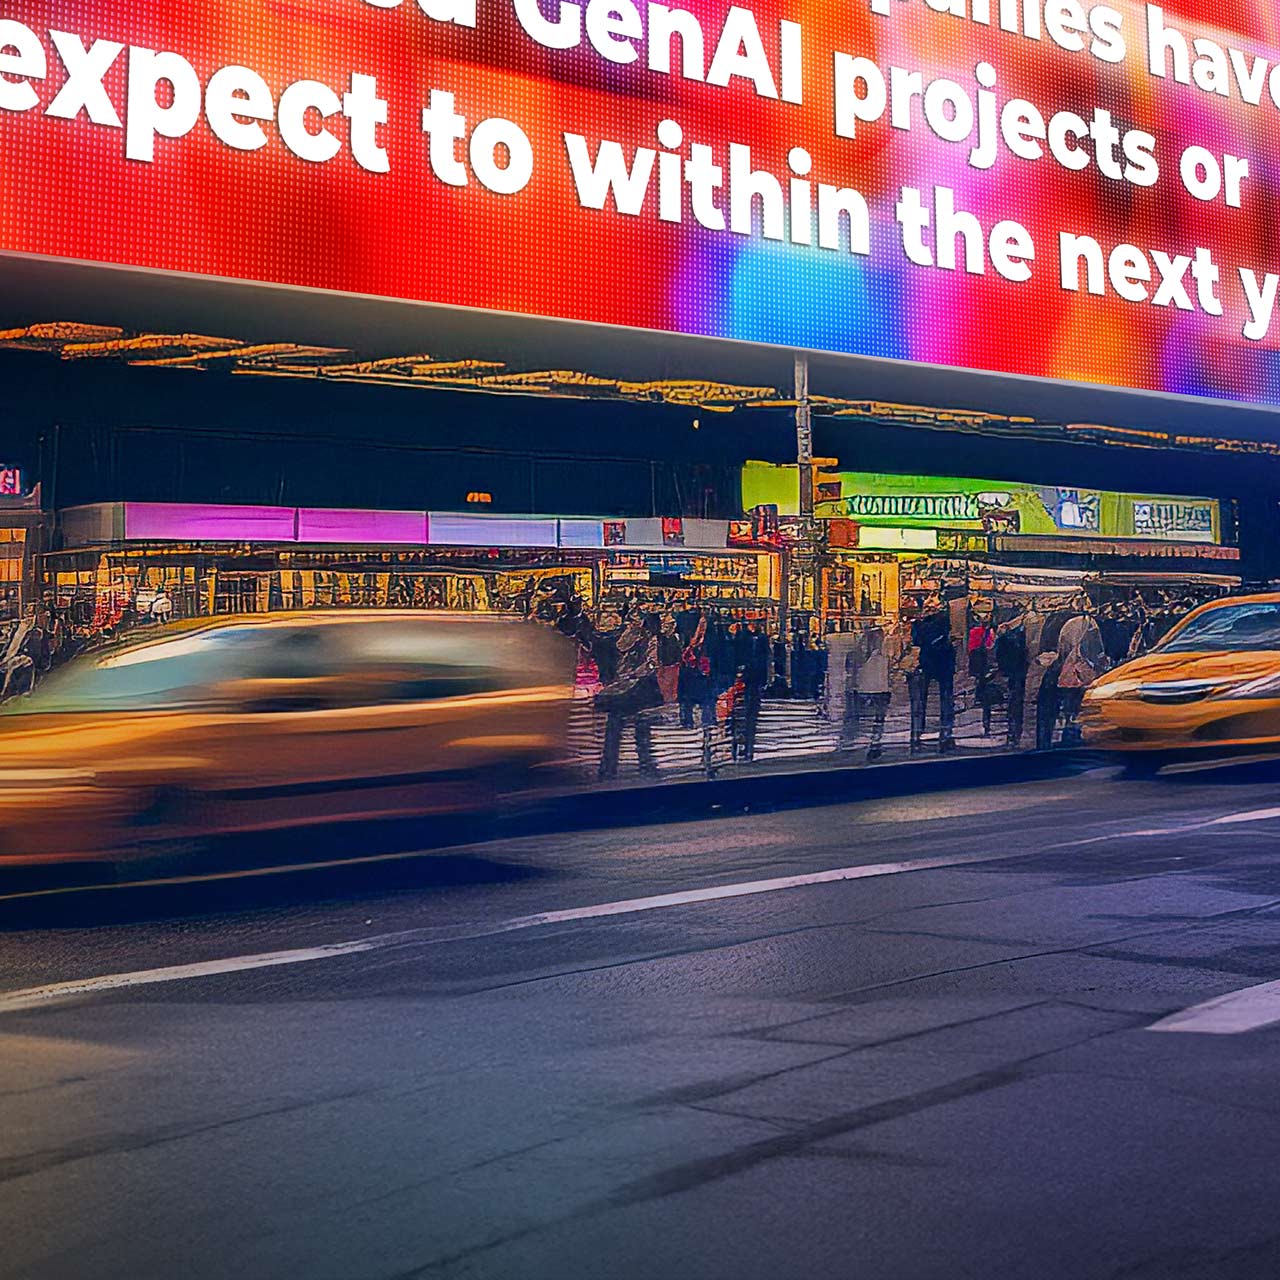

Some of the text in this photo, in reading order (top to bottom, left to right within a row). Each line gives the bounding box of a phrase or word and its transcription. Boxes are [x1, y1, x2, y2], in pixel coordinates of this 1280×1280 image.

[421, 88, 535, 195] to
[563, 118, 871, 256] within
[895, 185, 1036, 283] the
[1059, 231, 1224, 316] next
[833, 51, 1160, 188] projects
[1178, 144, 1250, 209] or
